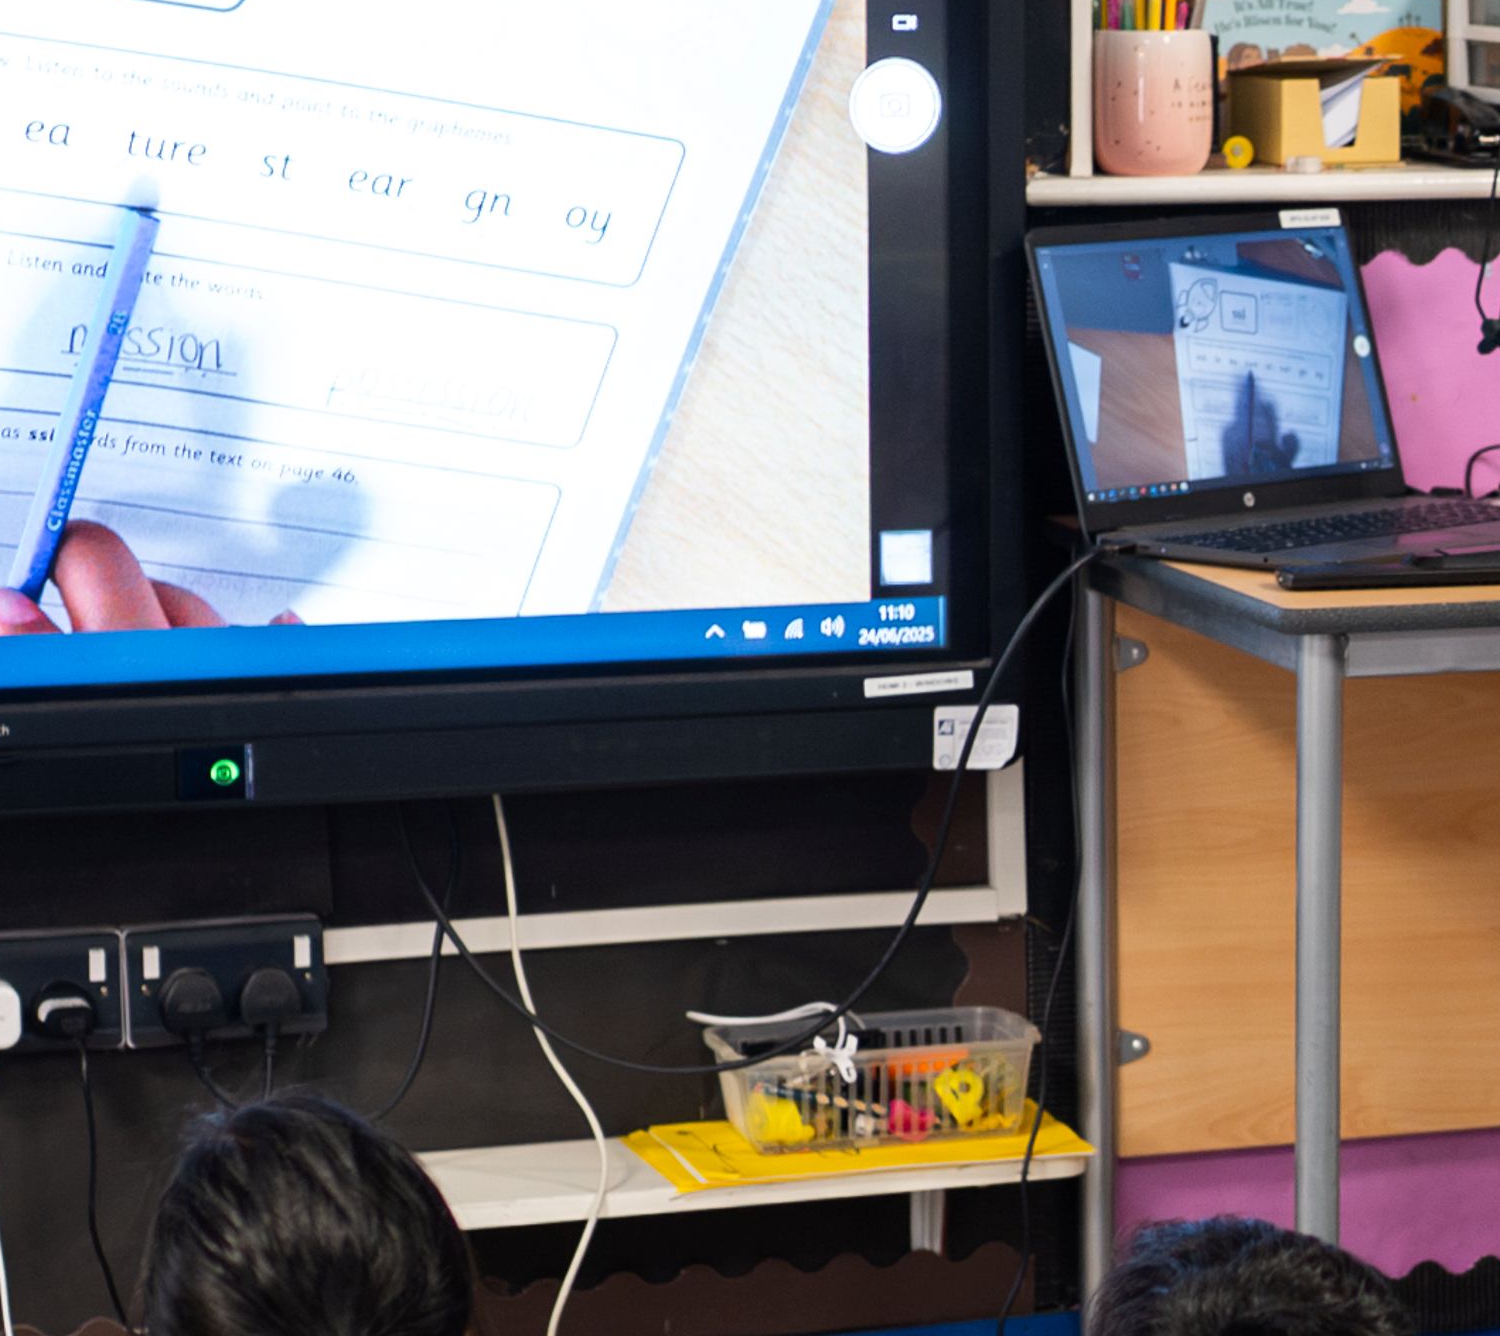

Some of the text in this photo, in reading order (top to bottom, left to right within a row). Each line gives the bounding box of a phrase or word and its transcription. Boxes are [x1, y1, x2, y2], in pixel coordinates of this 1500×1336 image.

[1285, 14, 1305, 27] for
[122, 70, 154, 89] the
[24, 118, 71, 148] ea
[126, 129, 208, 166] ture
[260, 152, 294, 181] st
[348, 168, 414, 199] ear
[463, 188, 513, 225] gn
[564, 203, 614, 245] oy
[6, 247, 64, 274] Listen
[70, 260, 109, 280] and
[169, 271, 201, 291] the
[0, 425, 21, 441] as
[120, 433, 167, 459] from
[173, 440, 203, 461] the
[208, 449, 244, 468] text
[278, 460, 325, 482] page
[46, 409, 99, 533] Classmaster
[878, 603, 916, 622] 11:10
[857, 624, 936, 646] 24/06/2025
